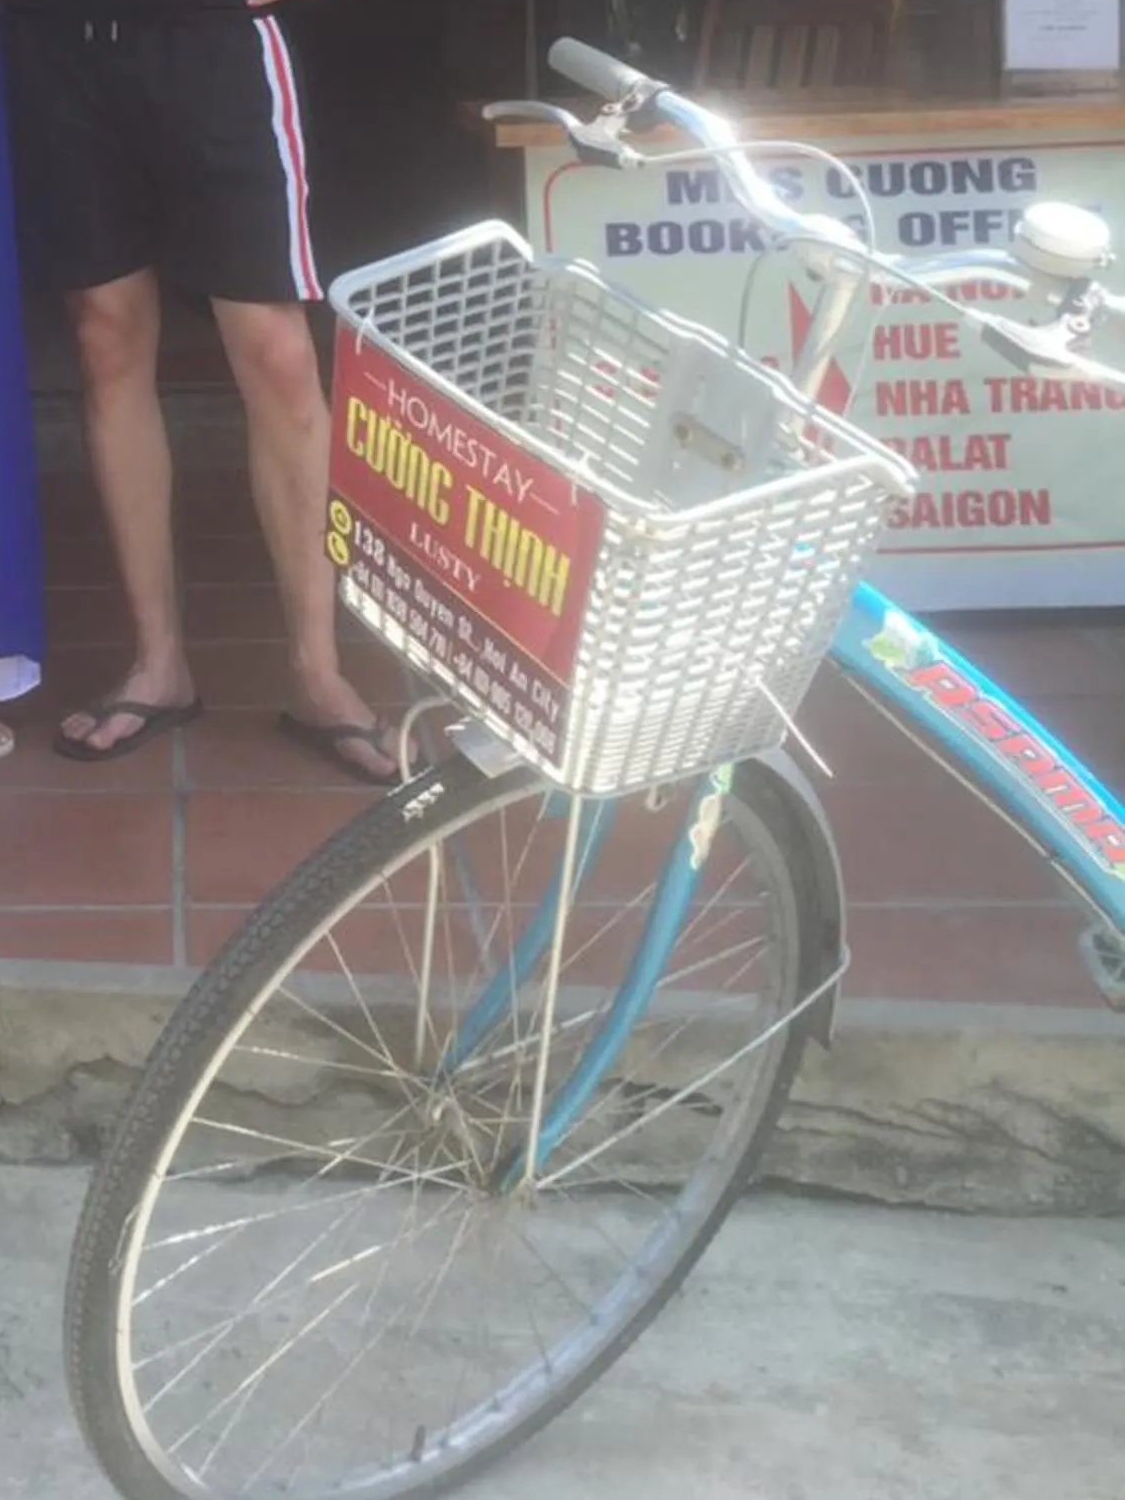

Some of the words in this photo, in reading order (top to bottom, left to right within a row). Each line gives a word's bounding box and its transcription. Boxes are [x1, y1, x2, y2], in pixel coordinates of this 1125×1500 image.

[666, 166, 803, 205] MS
[826, 156, 1038, 200] CUONG
[873, 322, 960, 360] HUE
[875, 379, 971, 417] NHA
[387, 378, 534, 504] HOMESTAY
[885, 488, 1052, 530] SAIGON
[355, 520, 385, 566] 138
[410, 521, 481, 593] LUSTY
